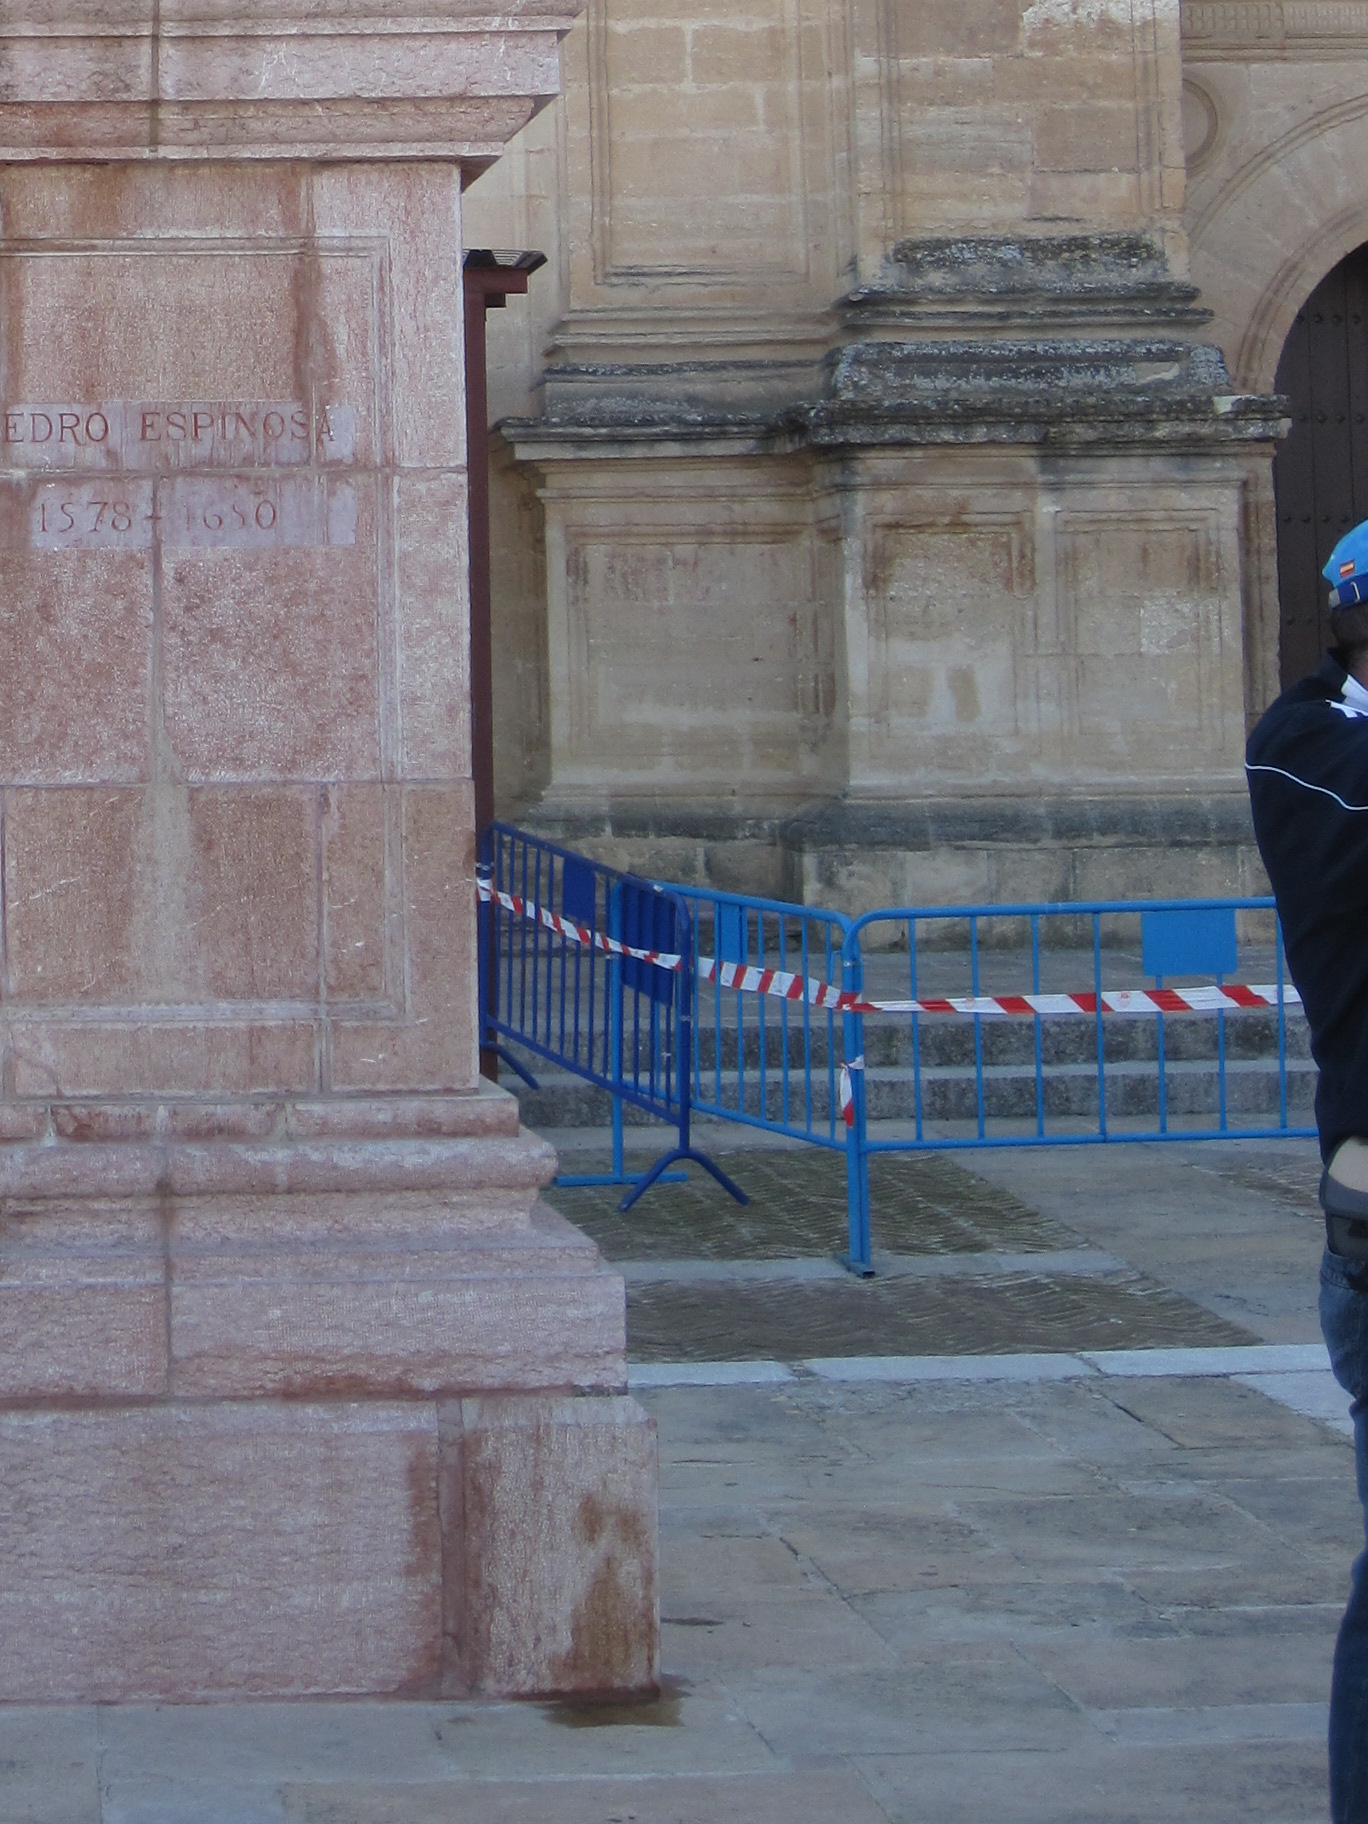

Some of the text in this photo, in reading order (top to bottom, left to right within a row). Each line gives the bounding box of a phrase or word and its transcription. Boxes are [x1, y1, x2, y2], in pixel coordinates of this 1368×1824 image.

[141, 410, 335, 444] ESPINOSA
[39, 501, 132, 533] 1578
[184, 499, 277, 532] 1650
